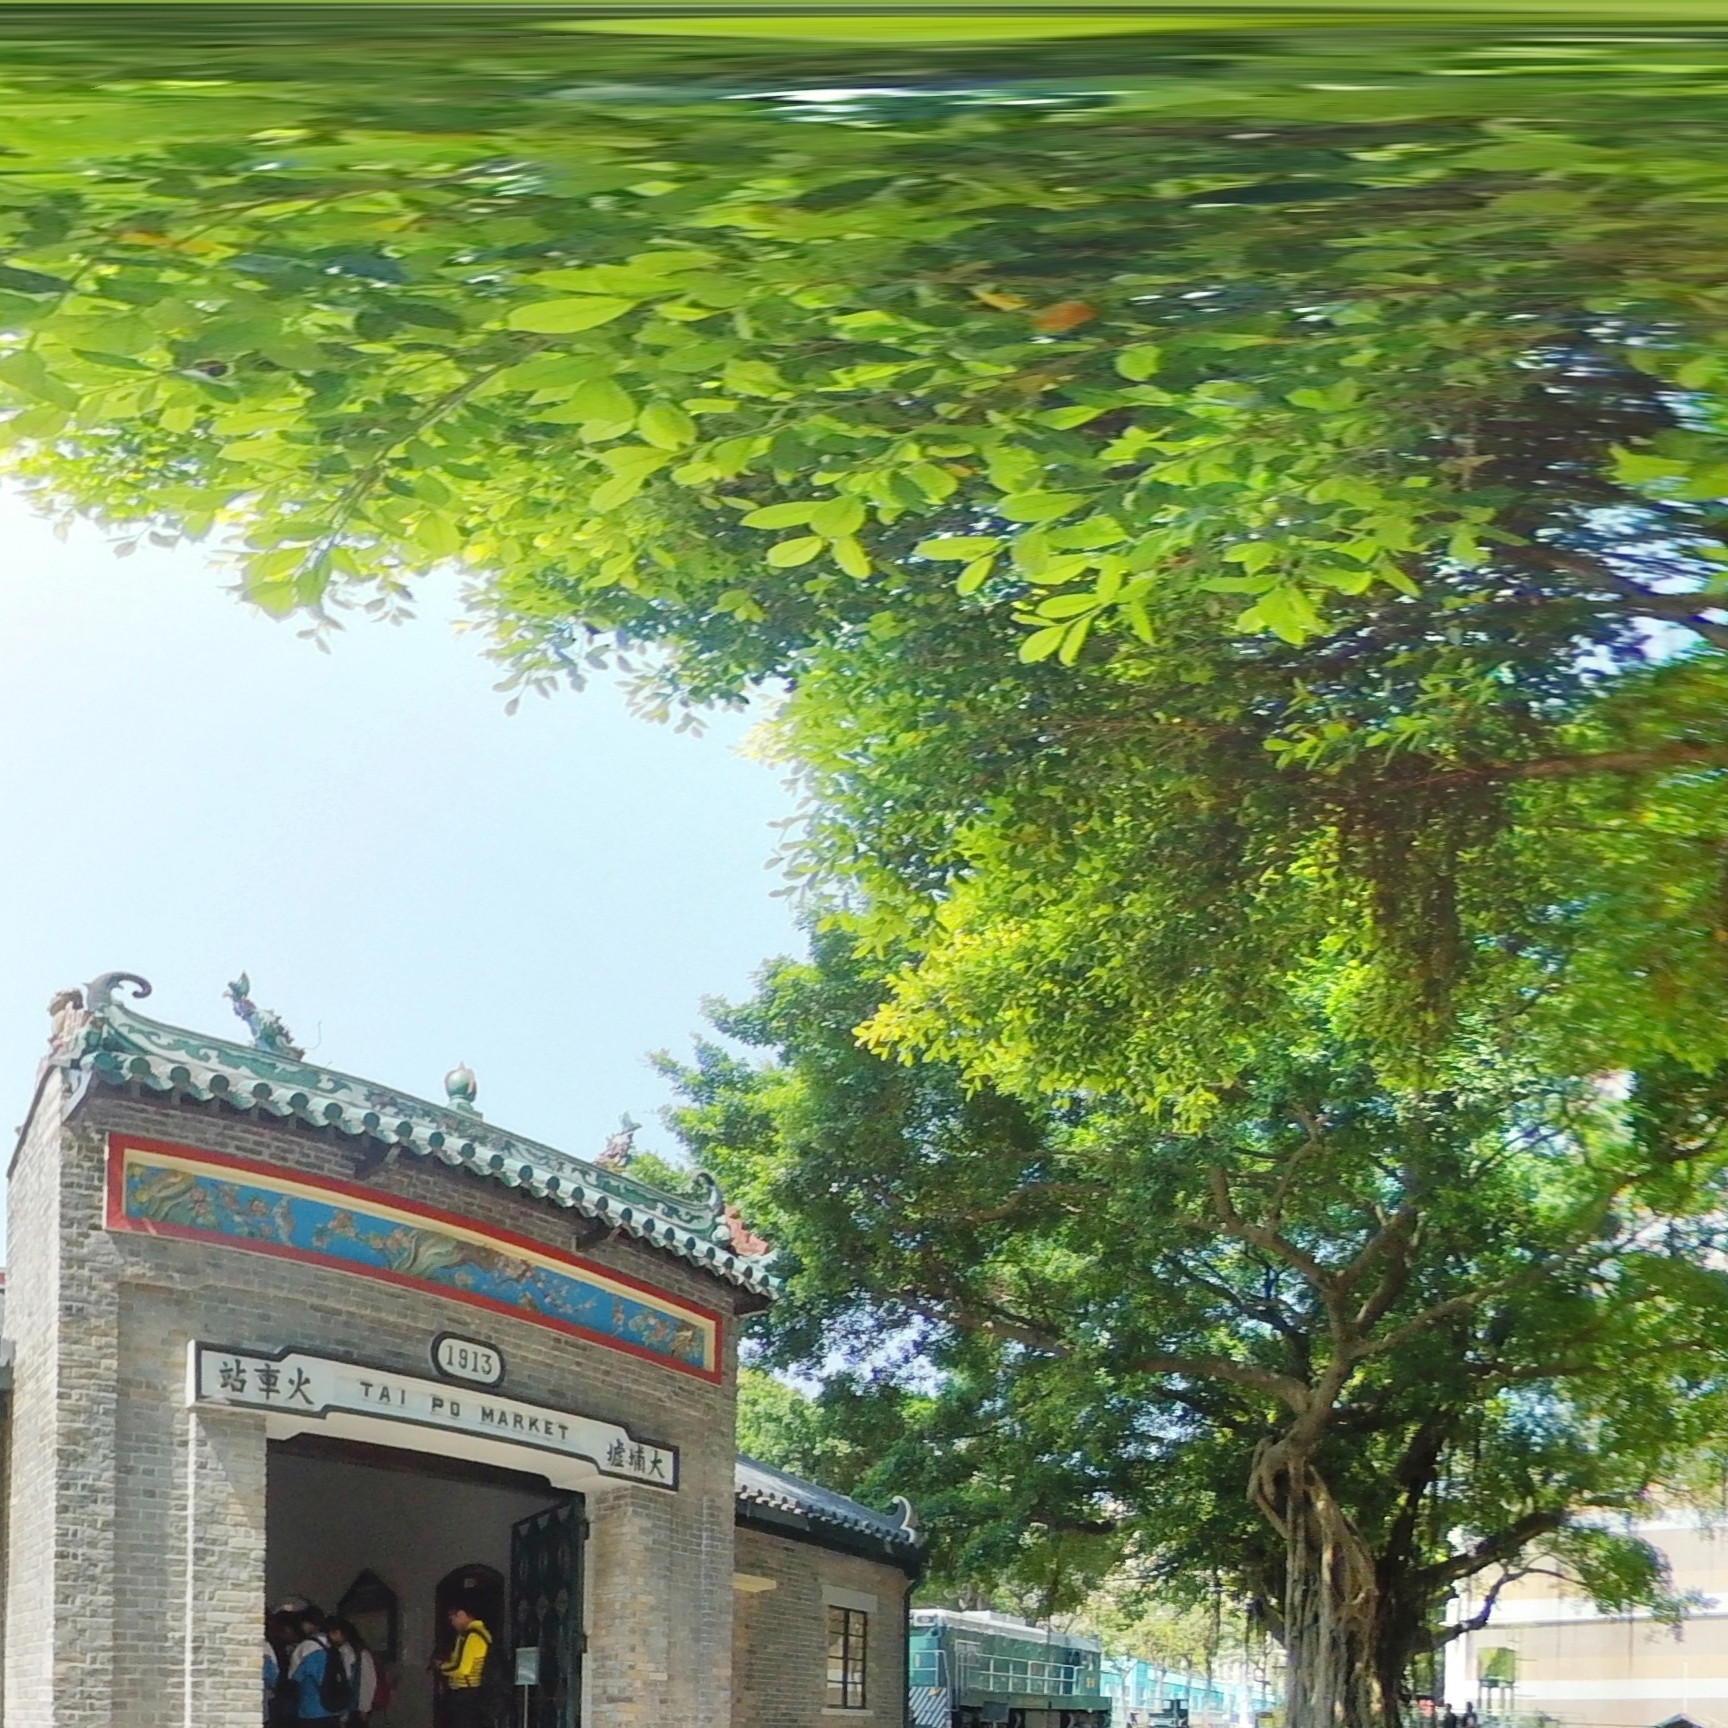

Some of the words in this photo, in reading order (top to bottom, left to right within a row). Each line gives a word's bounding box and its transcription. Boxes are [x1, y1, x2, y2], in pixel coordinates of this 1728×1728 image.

[445, 1344, 493, 1375] 1913
[359, 1381, 406, 1405] TAI
[430, 1396, 461, 1417] PO
[481, 1406, 570, 1441] MARKET
